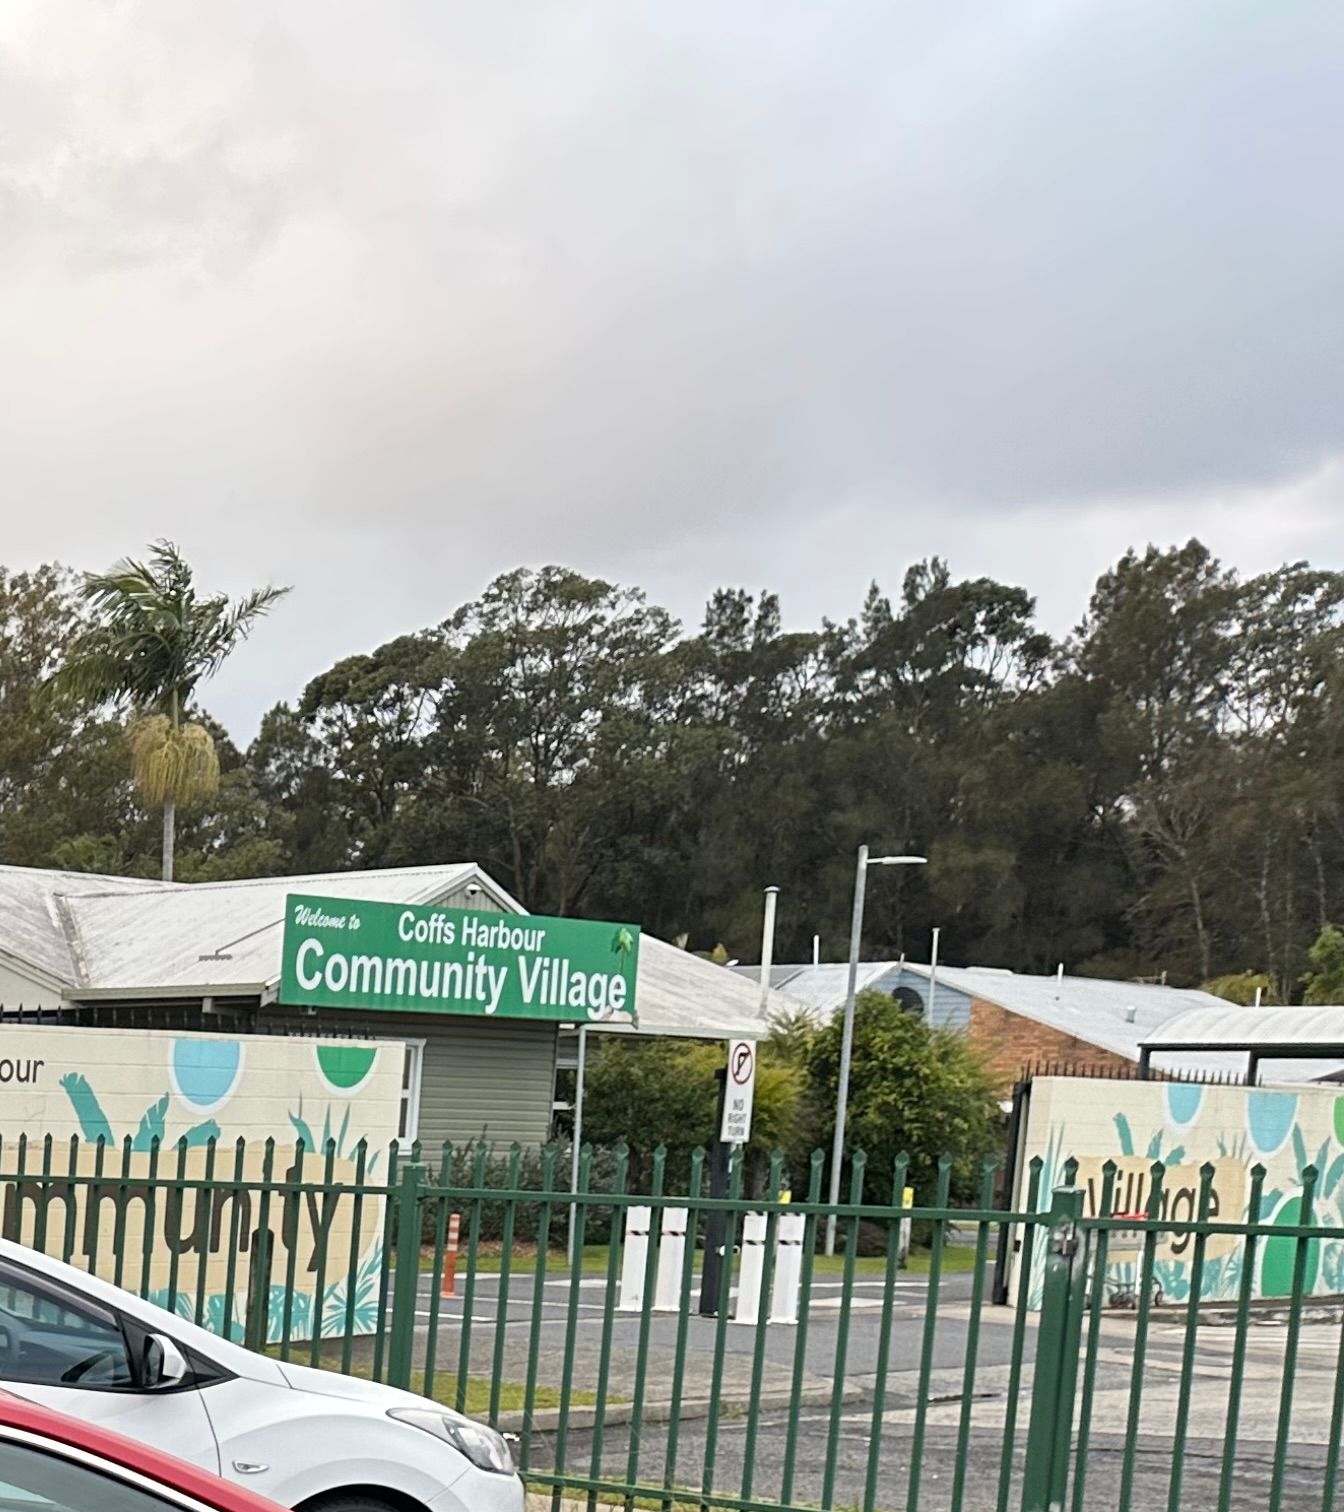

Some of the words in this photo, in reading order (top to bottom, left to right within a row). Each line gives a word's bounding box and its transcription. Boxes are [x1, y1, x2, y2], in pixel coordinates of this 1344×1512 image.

[294, 904, 346, 929] Welcome
[348, 913, 361, 930] to
[398, 910, 456, 945] Coffs
[461, 916, 546, 952] Harbour
[295, 938, 508, 1015] Community
[518, 955, 627, 1021] Village
